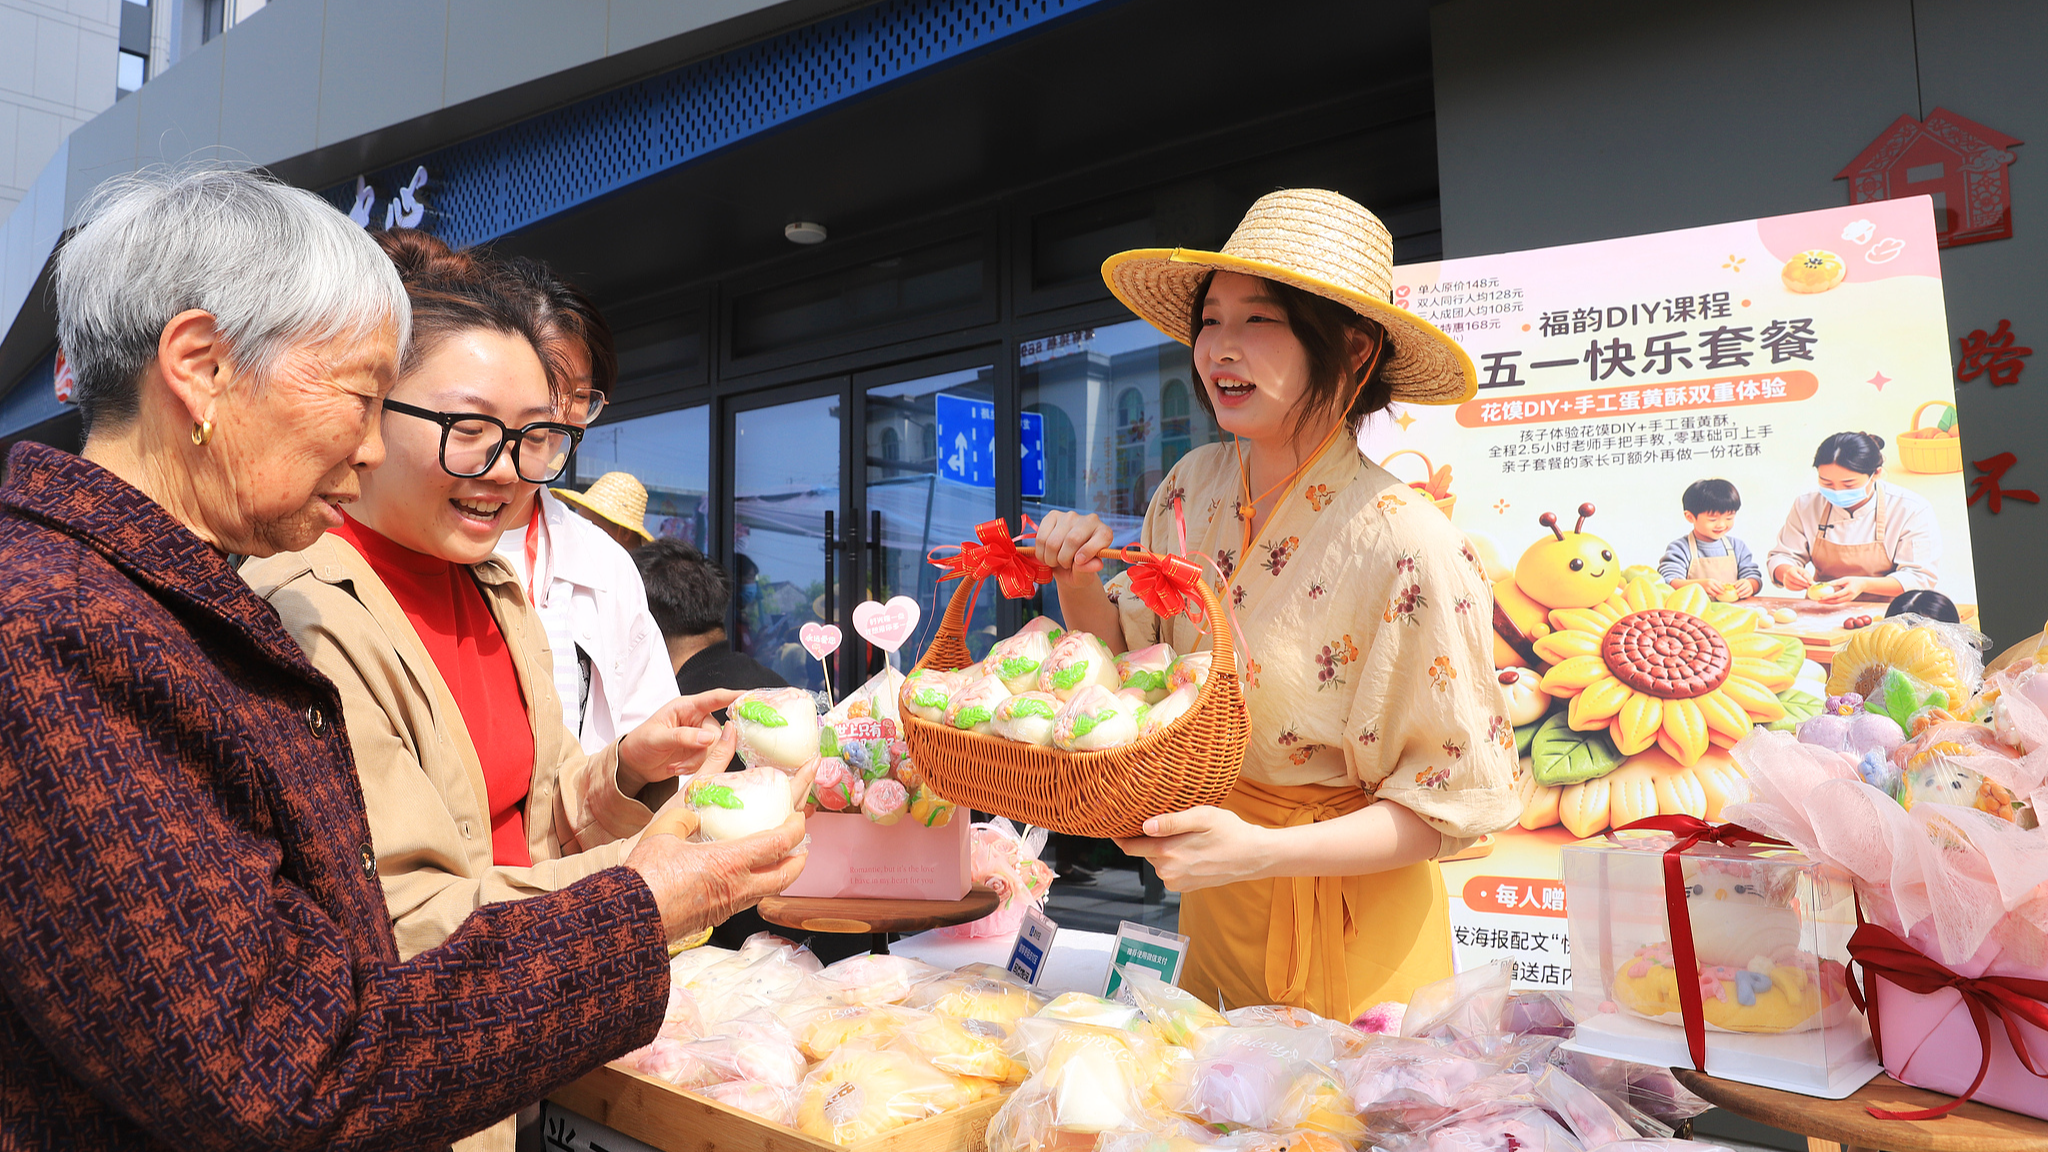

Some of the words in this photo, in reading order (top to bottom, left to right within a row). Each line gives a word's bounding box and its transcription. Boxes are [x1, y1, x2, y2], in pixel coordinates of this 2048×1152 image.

[1418, 276, 1500, 295] 单人原价148元
[1417, 287, 1524, 309] 双人同行人均128元
[1417, 301, 1524, 322] 三人成团人均108元
[1538, 290, 1733, 338] 福韵DIY课程
[1478, 317, 1819, 390] 五一快乐套餐
[1480, 375, 1788, 424] 花馍DIY+手工蛋黄酥双重体验
[1501, 443, 1762, 474] 亲子套餐的家长可额外再做一份花酥
[834, 722, 882, 738] 世上只有
[884, 865, 895, 873] but
[908, 865, 919, 873] the
[920, 864, 935, 873] love
[1495, 884, 1567, 911] 每人赠
